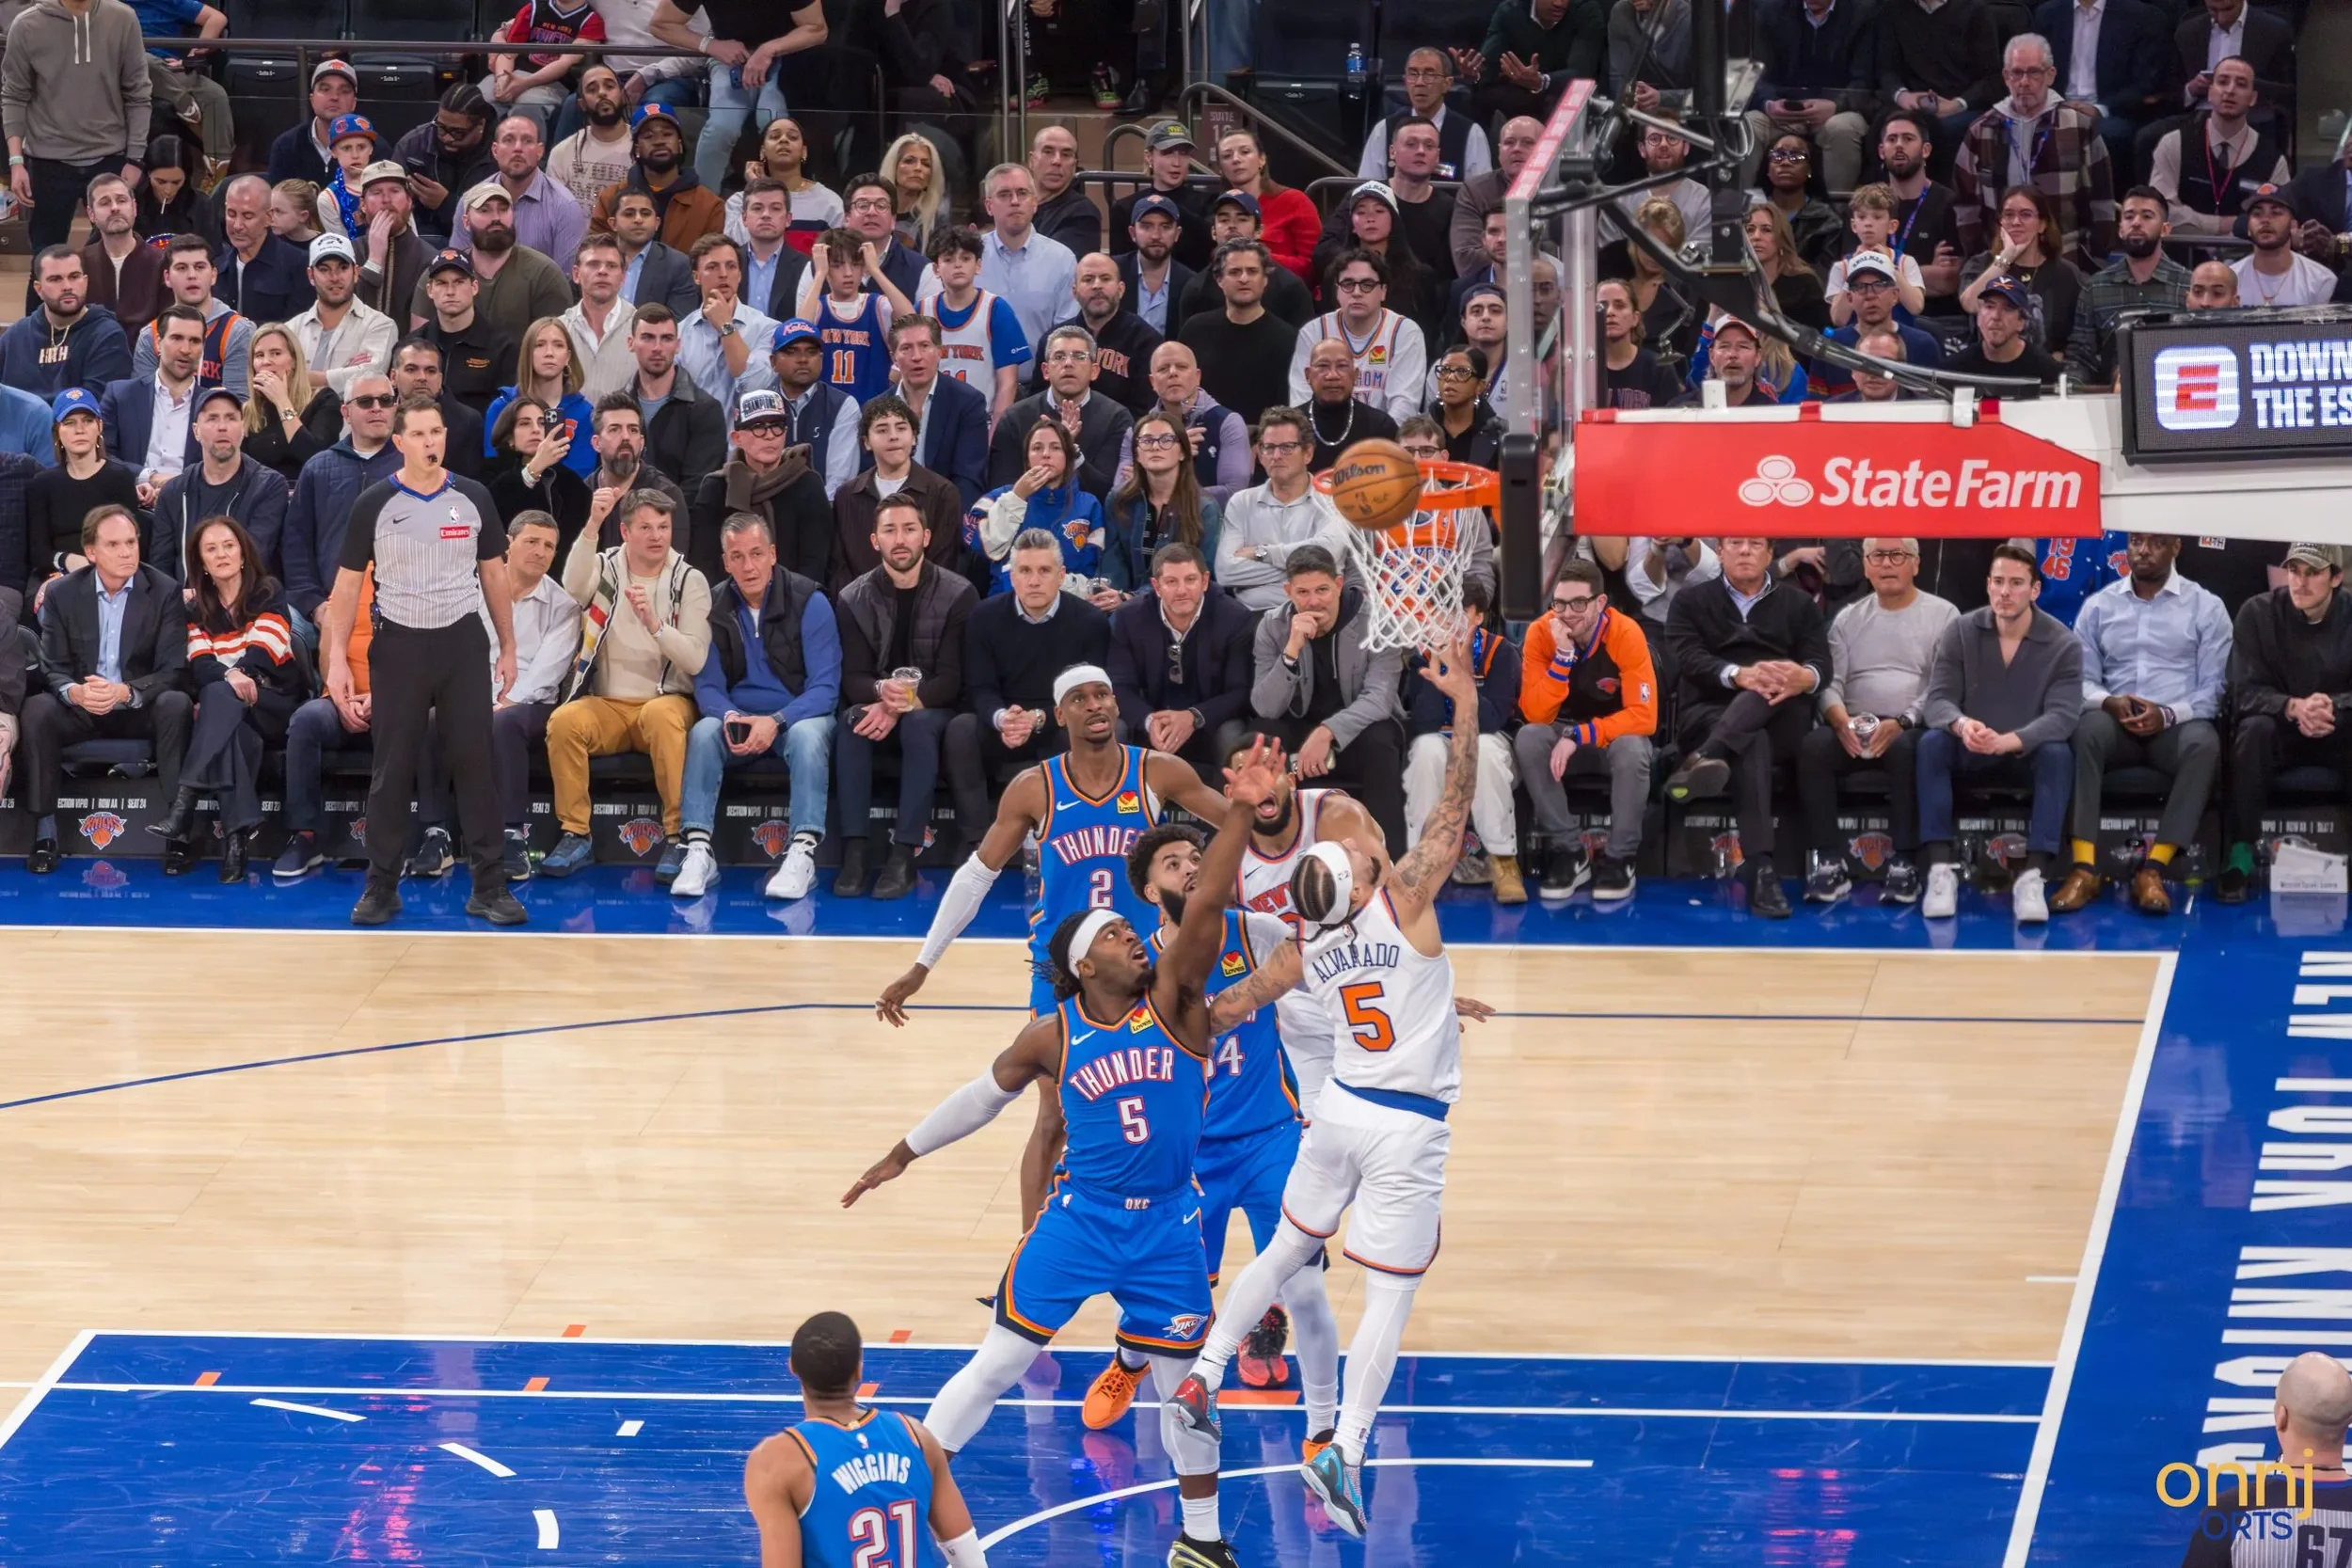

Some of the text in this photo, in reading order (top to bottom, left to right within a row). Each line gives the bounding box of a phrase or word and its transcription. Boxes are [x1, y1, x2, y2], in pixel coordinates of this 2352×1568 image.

[1210, 111, 1234, 122] SUITE
[843, 330, 871, 347] YORK
[832, 349, 854, 385] 11
[1096, 347, 1131, 378] YORK
[2251, 387, 2314, 429] THE
[1333, 463, 1386, 486] Wilson
[440, 529, 469, 537] Emirates
[2041, 554, 2072, 580] 46
[57, 798, 75, 808] ECTION
[1050, 824, 1145, 867] THUNDE
[1089, 867, 1114, 911] 2
[1248, 882, 1289, 914] NEW
[1312, 942, 1400, 984] ALVARADO
[1338, 981, 1397, 1053] 5
[1069, 1045, 1175, 1102] THUNDER
[1207, 1035, 1246, 1079] 4
[1116, 1095, 1151, 1145] 5
[1124, 1196, 1151, 1211] OKC
[1172, 1316, 1198, 1335] OKC
[831, 1451, 912, 1496] WIGGINS
[848, 1497, 917, 1568] 21
[2296, 1524, 2352, 1568] 67
